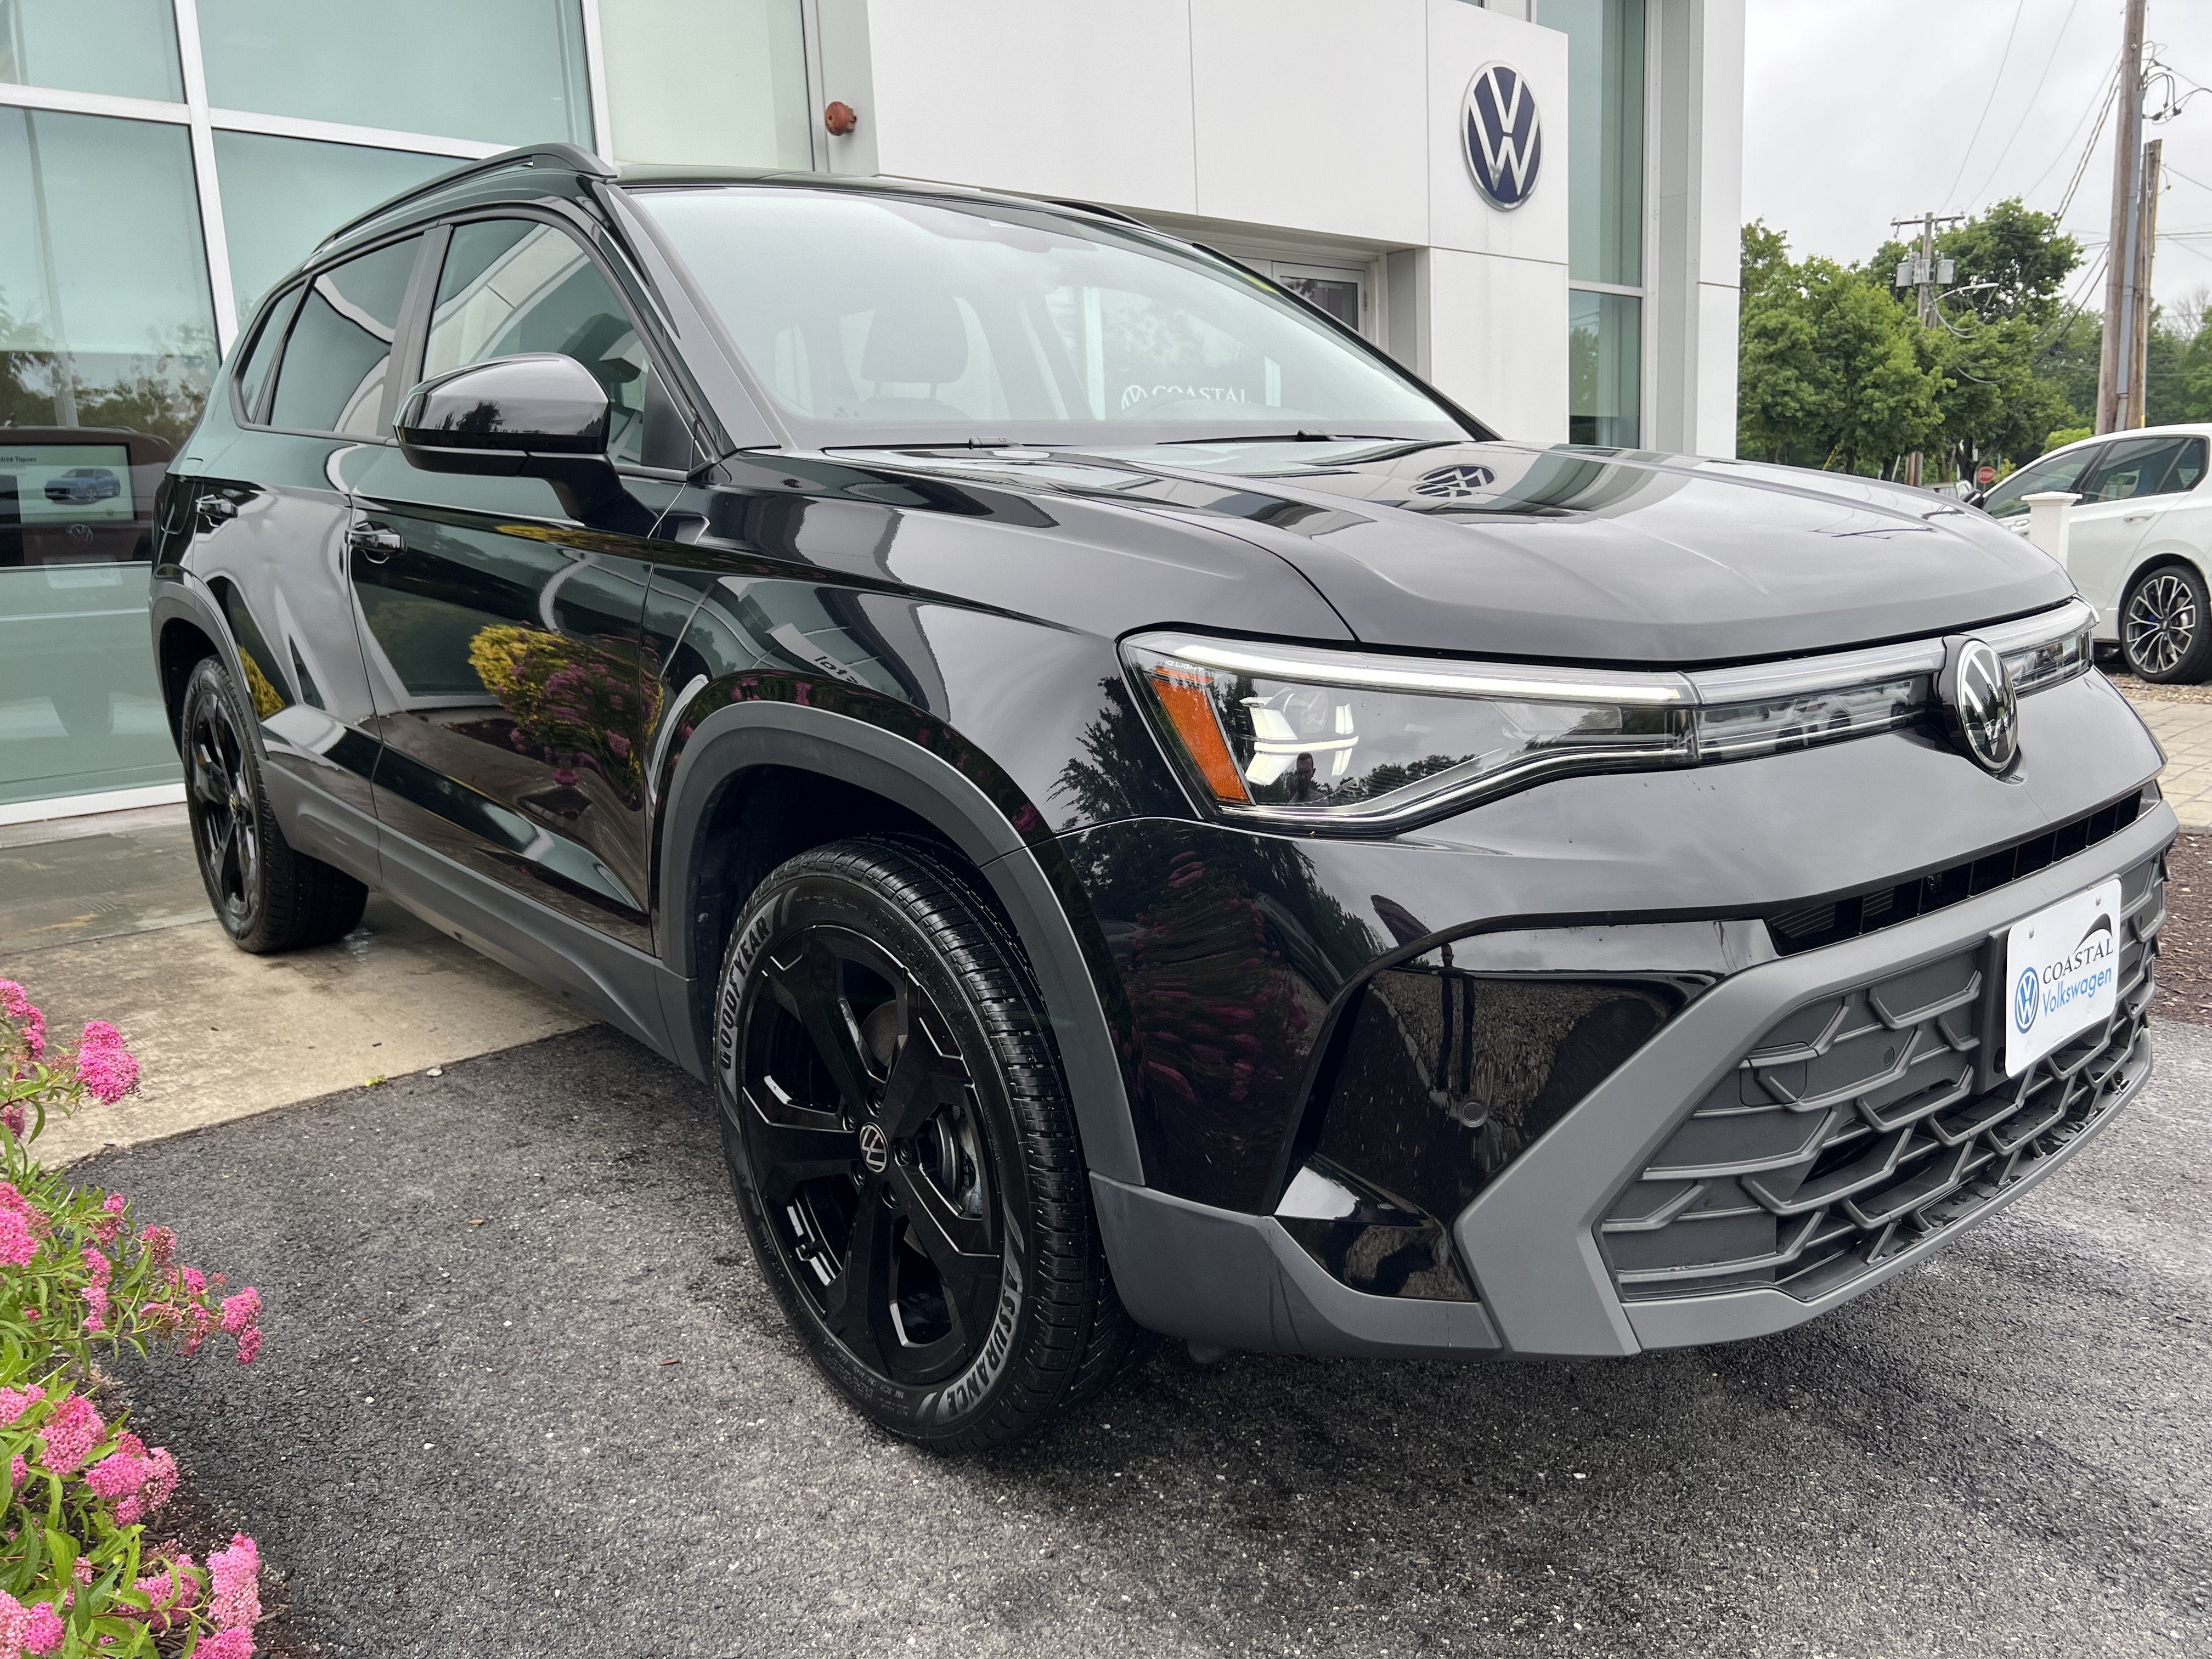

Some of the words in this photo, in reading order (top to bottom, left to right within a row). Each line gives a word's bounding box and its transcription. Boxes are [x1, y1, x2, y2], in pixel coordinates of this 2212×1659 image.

[1461, 60, 1544, 212] VW
[1164, 659, 1204, 673] IQ.LIGHT
[719, 916, 771, 1070] GOODYEAR
[2042, 937, 2114, 985] COASTAL
[2042, 967, 2112, 1017] Volkswagen
[946, 1262, 1019, 1417] ASSURANCE
